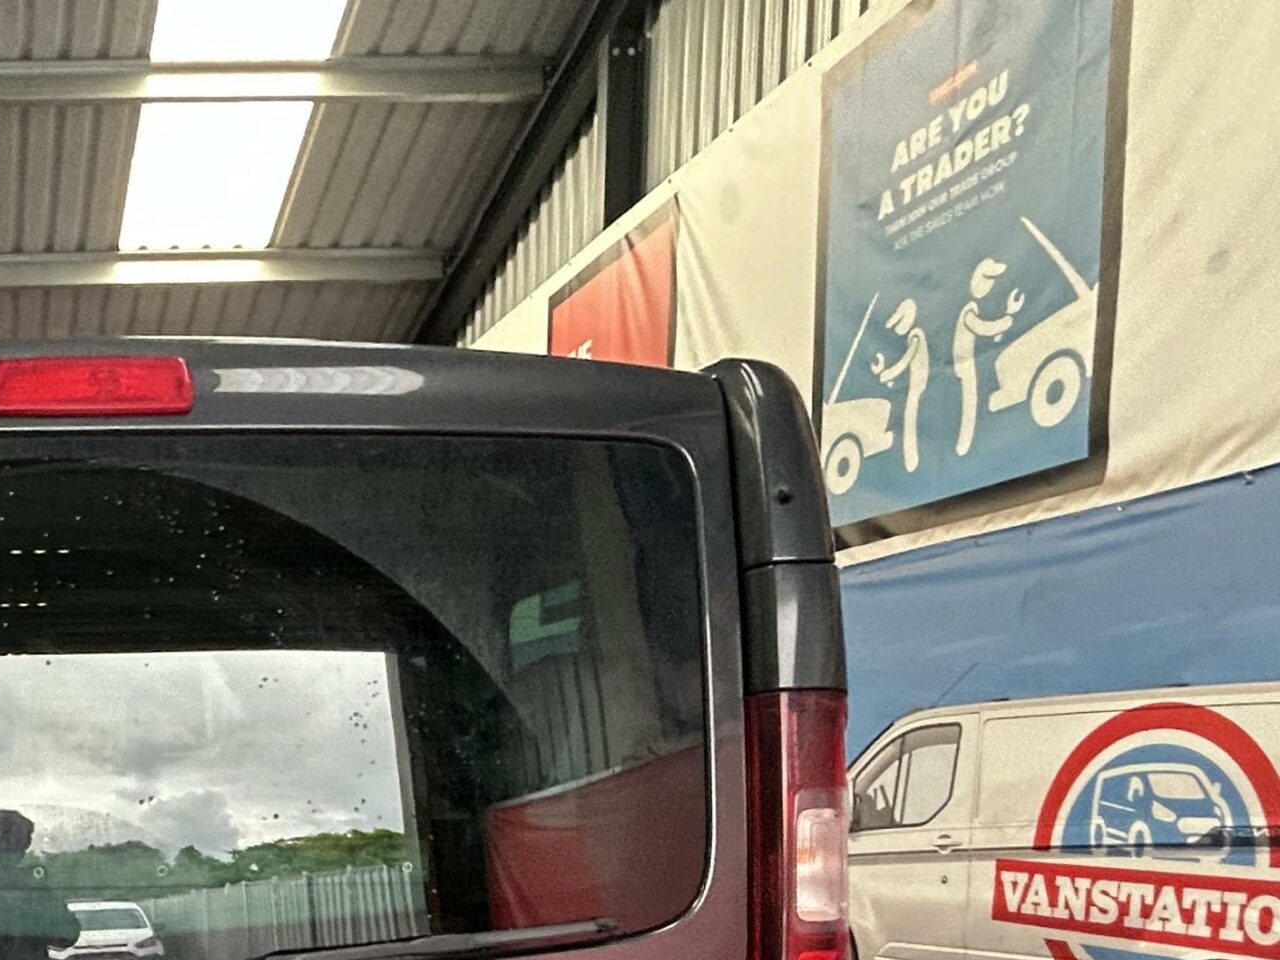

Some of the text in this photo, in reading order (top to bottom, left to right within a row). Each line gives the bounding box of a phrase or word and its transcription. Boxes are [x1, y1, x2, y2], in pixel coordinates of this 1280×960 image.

[877, 103, 1031, 220] A TRADER?
[889, 113, 945, 173] ARE
[947, 68, 1009, 134] YOU
